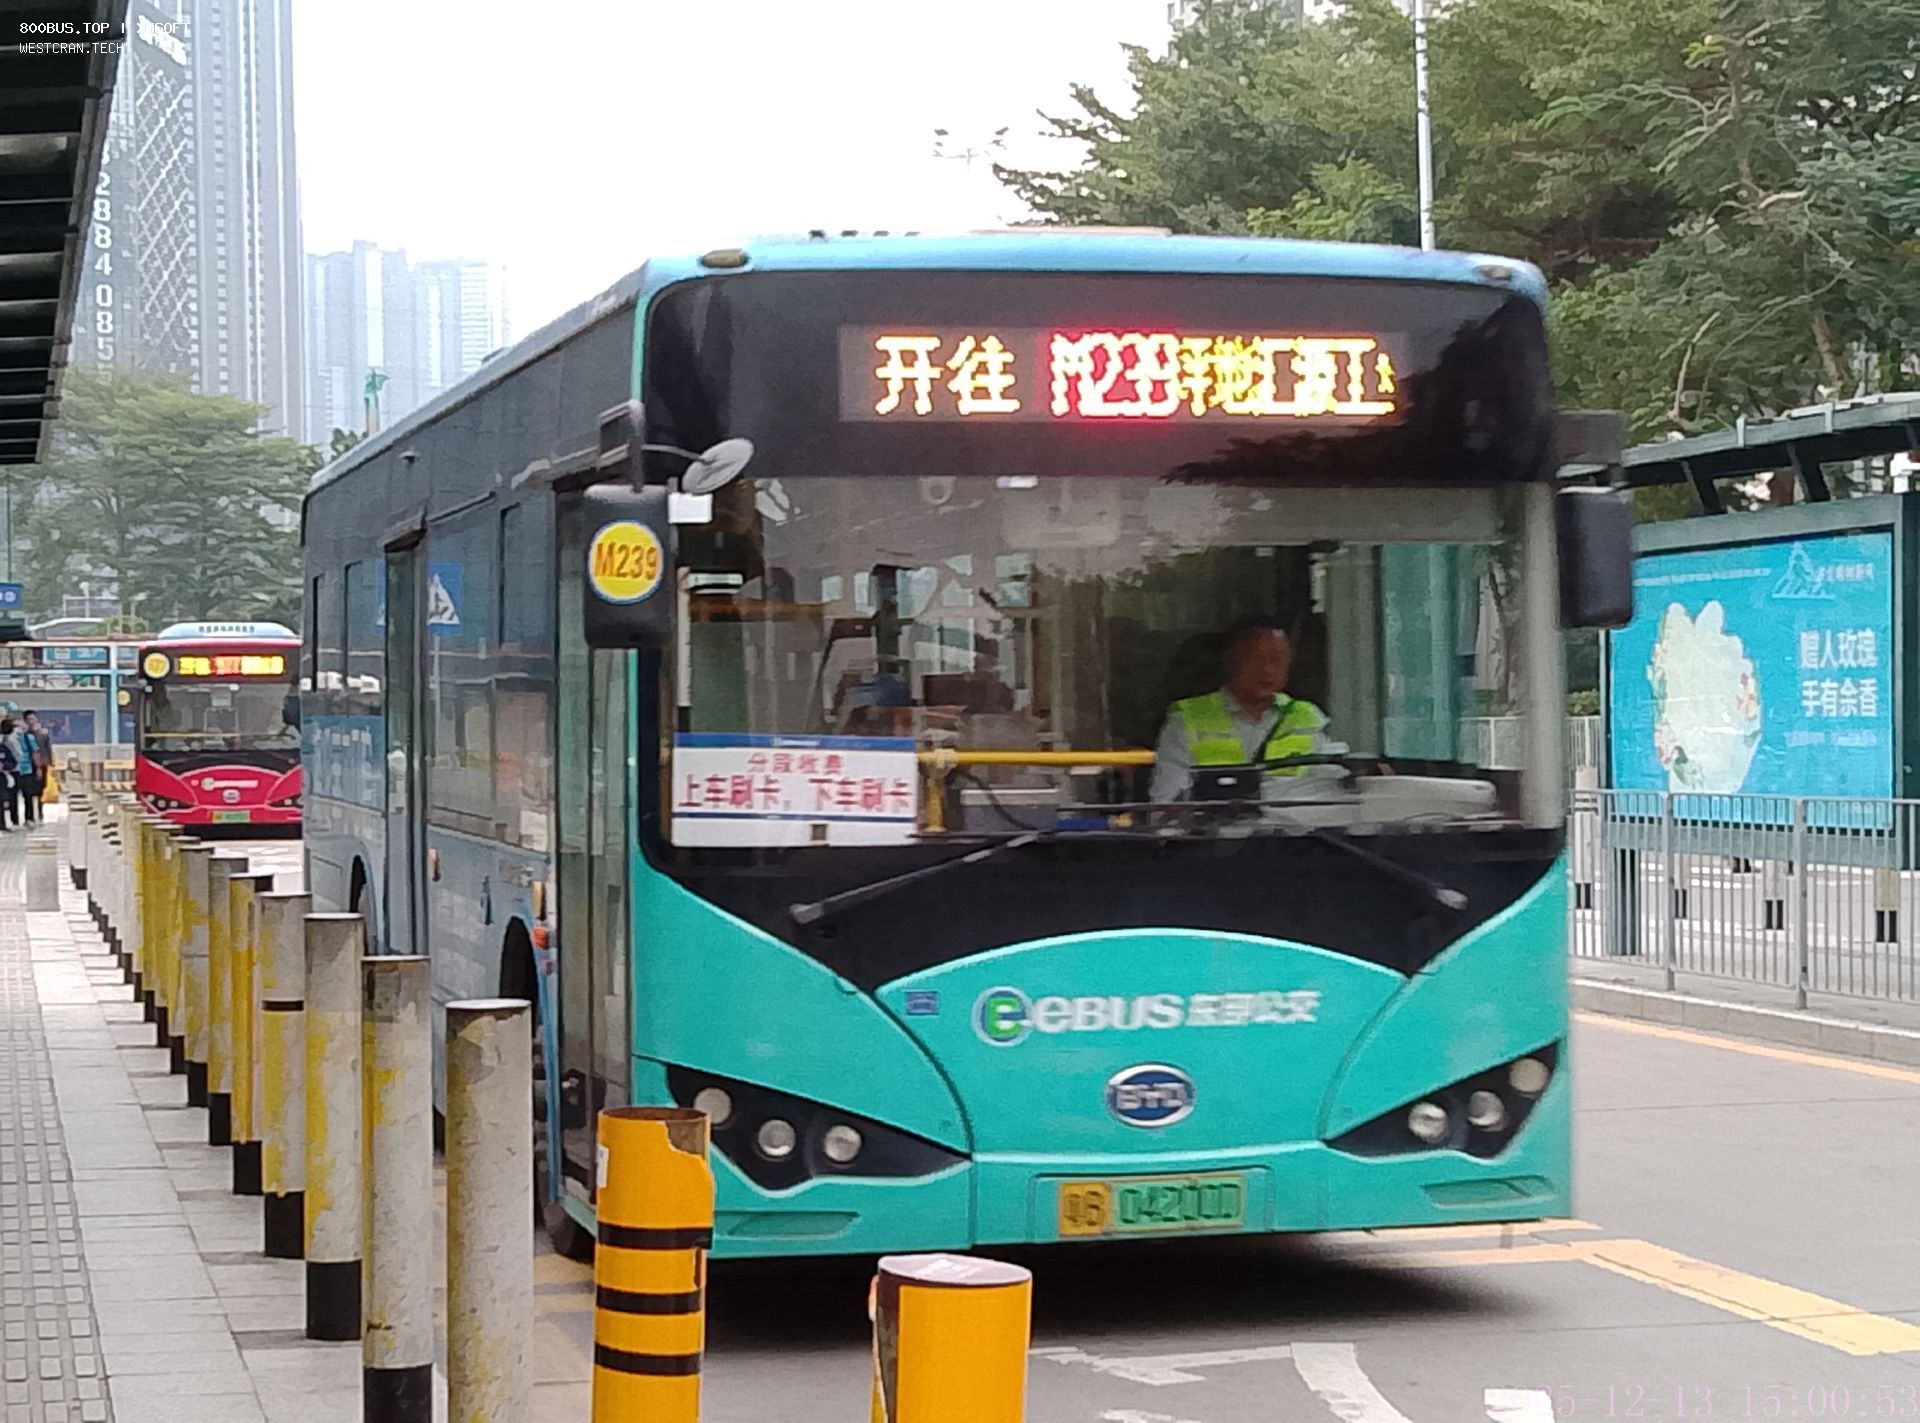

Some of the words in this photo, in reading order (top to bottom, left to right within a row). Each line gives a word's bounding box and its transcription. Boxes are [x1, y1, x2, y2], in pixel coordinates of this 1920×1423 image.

[875, 335, 1021, 415] 开往
[594, 542, 658, 580] M239
[1802, 677, 1878, 718] 手有余香
